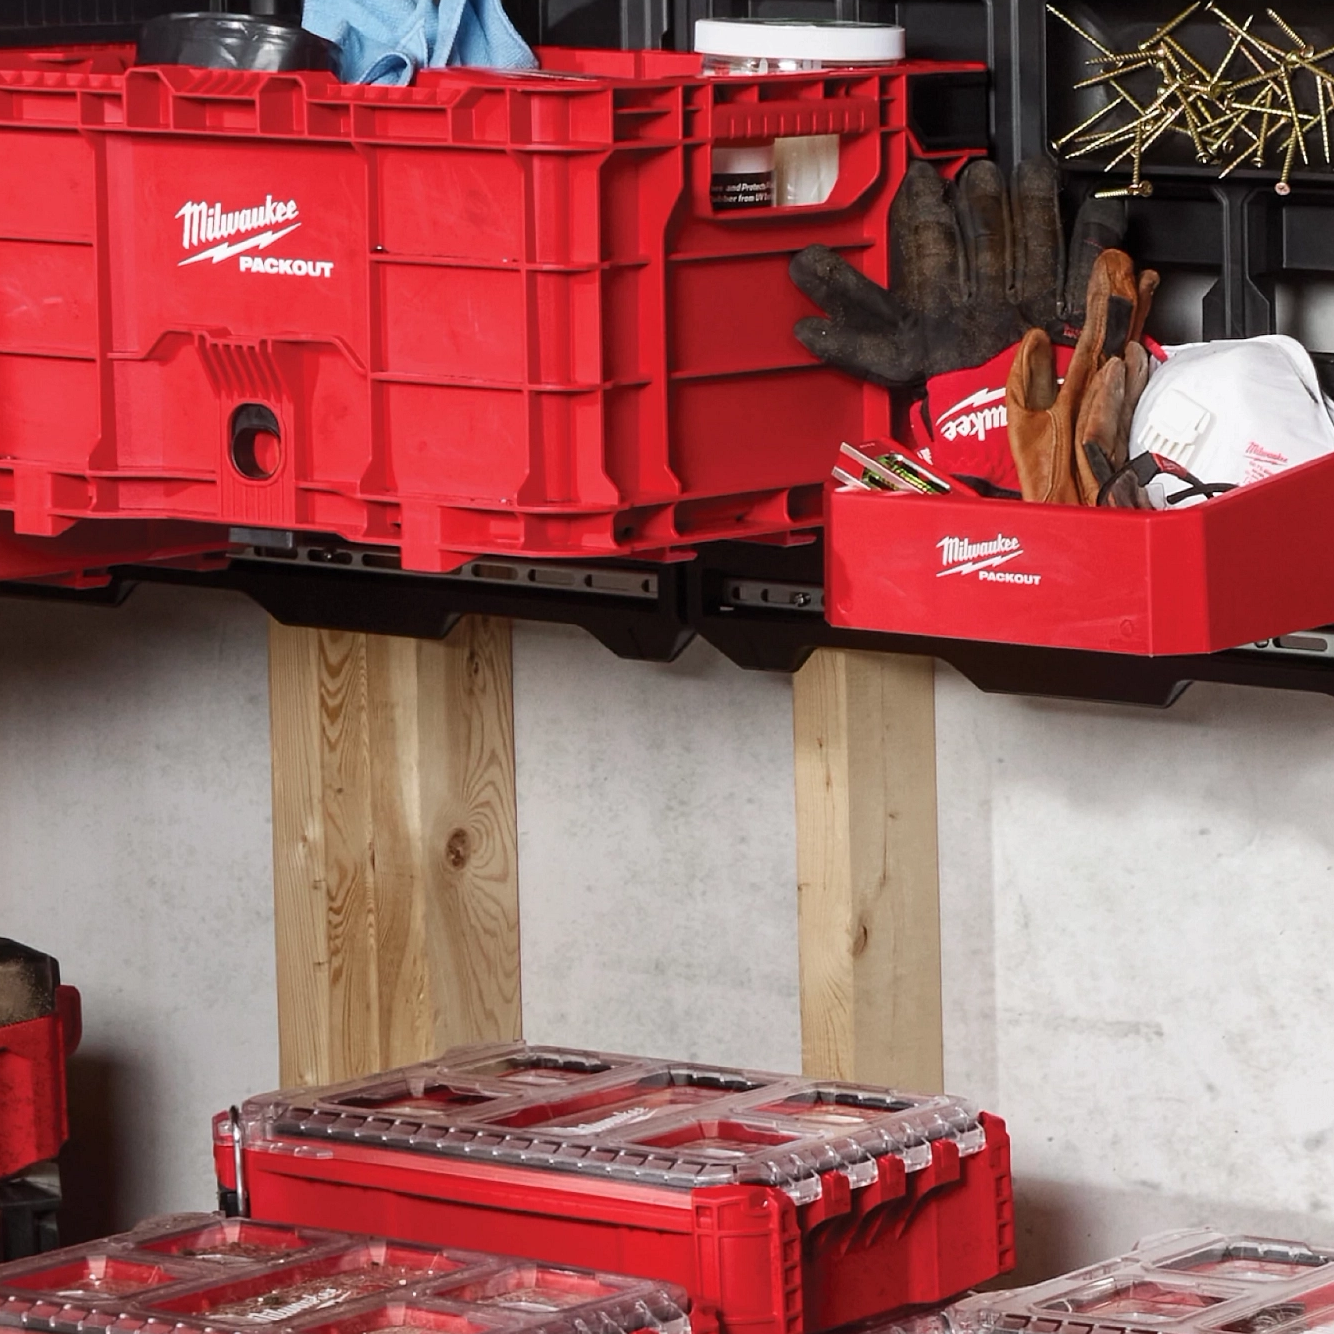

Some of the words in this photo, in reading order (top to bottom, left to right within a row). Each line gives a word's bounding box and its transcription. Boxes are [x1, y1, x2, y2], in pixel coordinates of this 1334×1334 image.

[174, 194, 300, 250] Milwaukee
[239, 255, 334, 278] PACKOUT
[936, 533, 1020, 566] Milwaukee
[978, 569, 1042, 585] PACKOUT
